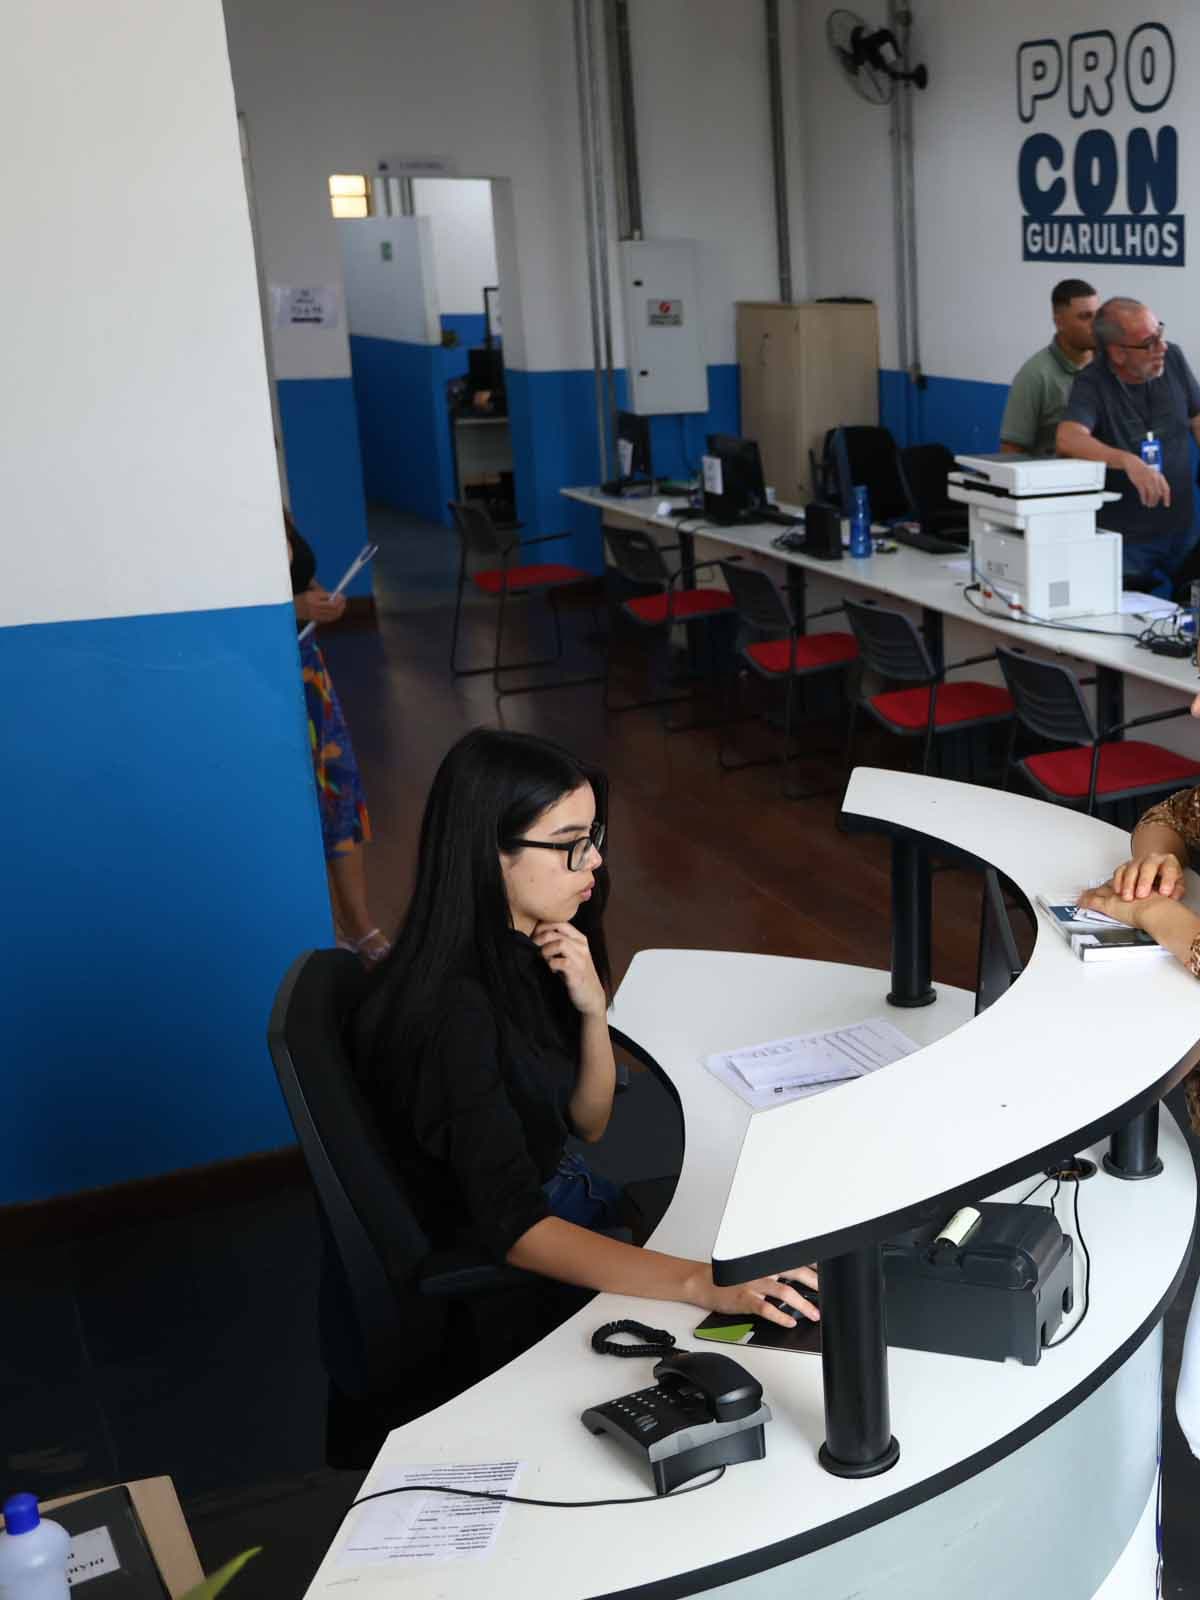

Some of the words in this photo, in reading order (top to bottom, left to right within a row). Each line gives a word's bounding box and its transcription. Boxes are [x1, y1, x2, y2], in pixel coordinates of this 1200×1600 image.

[1017, 22, 1175, 123] PRO
[1018, 125, 1178, 216] CON
[1026, 222, 1178, 258] GUARULHOS
